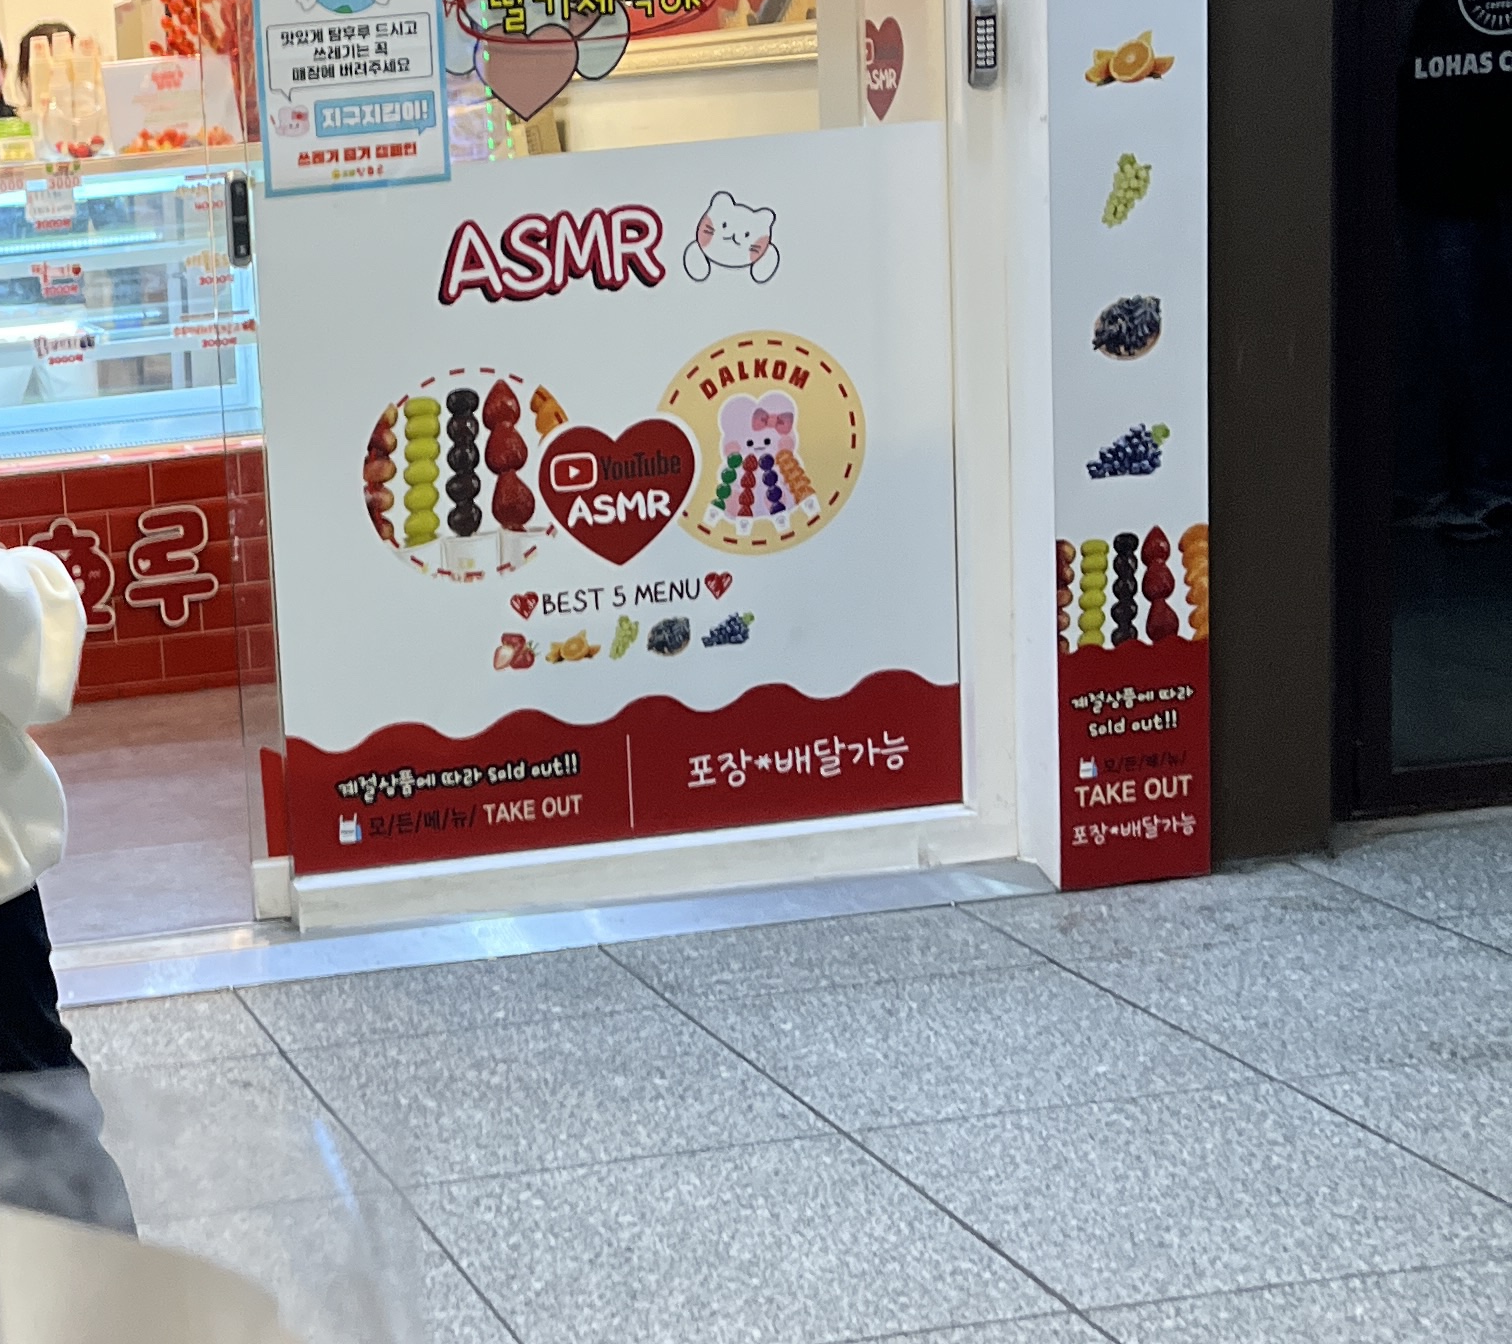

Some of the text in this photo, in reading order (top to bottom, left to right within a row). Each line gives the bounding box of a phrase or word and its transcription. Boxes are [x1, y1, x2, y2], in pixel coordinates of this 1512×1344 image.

[281, 27, 324, 46] 맛있게
[375, 19, 418, 38] 드시고
[313, 44, 370, 62] 쓰레기는
[1414, 51, 1494, 80] LOHAS
[292, 57, 411, 82] 매장에 버려주세요
[438, 204, 666, 306] ASMR
[699, 358, 811, 400] DALKOM
[600, 451, 682, 482] YouTube
[567, 490, 673, 530] ASMR
[541, 578, 702, 615] BEST 5 MENU
[1070, 685, 1196, 715] 계절상품에 따라
[1088, 709, 1179, 738] Sold out!!
[337, 752, 579, 805] 계절상품에 따라 Sold out!!
[1074, 773, 1194, 809] TAKE OUT
[482, 798, 537, 826] TAKE
[541, 794, 584, 818] OUT
